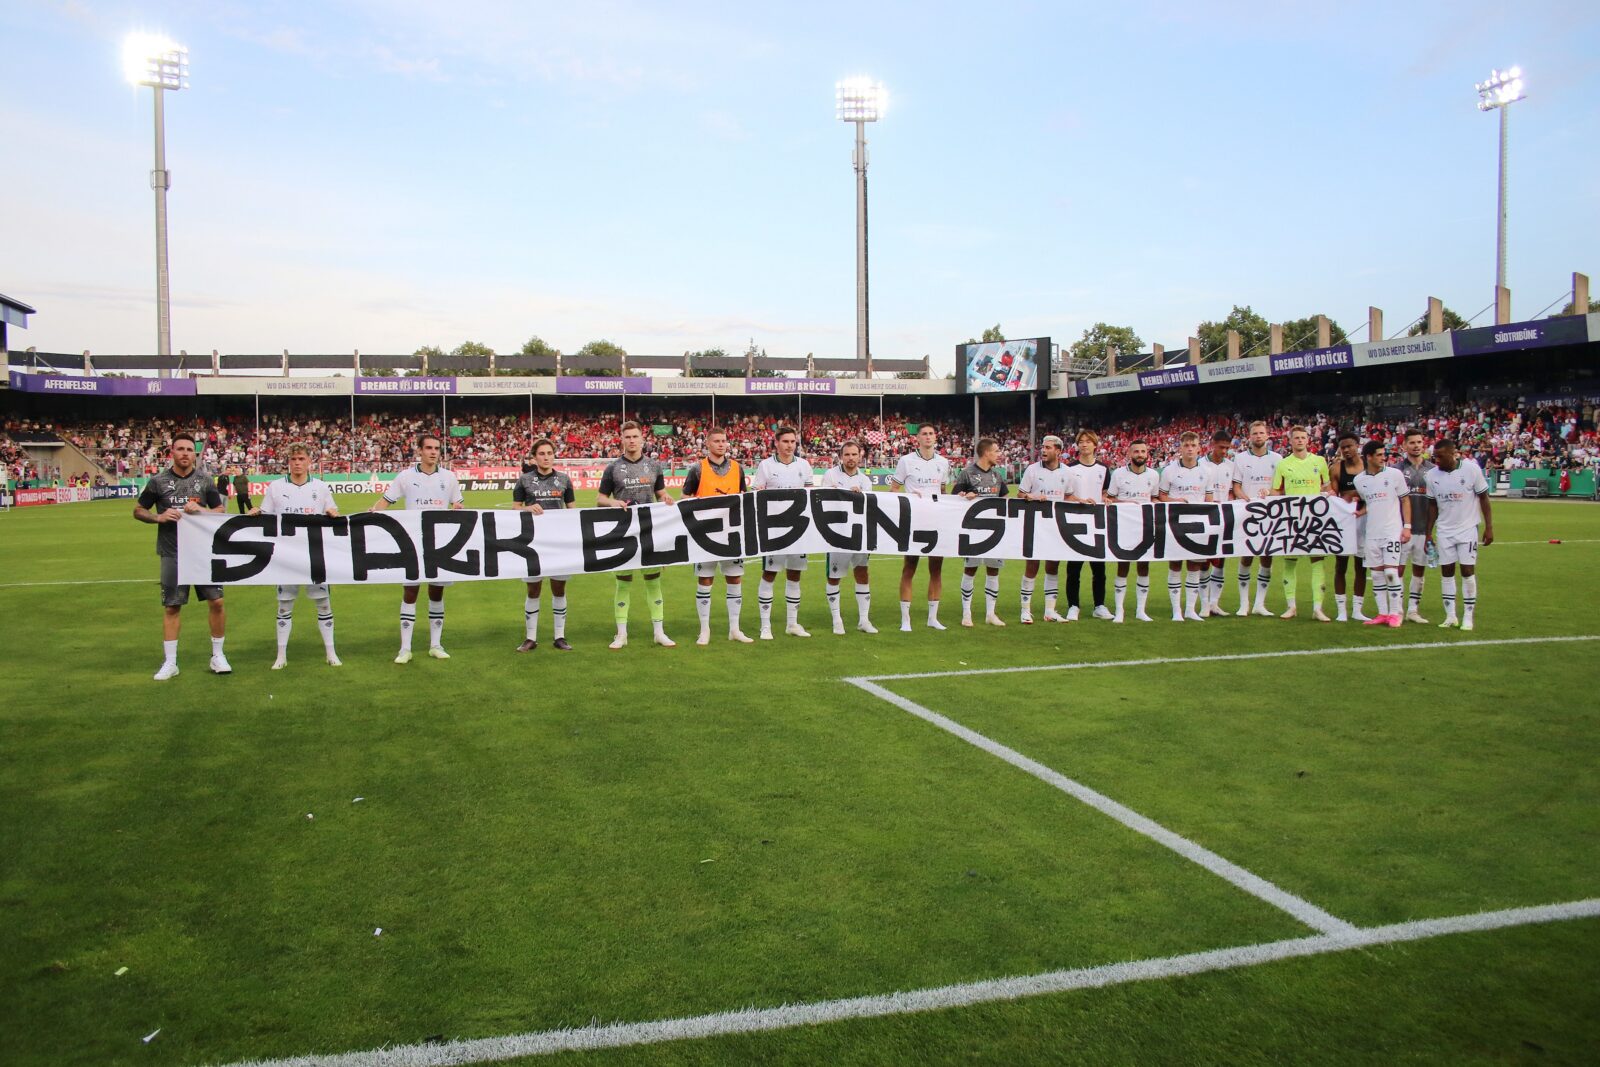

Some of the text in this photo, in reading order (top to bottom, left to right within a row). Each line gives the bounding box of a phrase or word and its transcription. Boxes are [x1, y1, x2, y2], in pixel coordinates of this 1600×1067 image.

[1274, 356, 1304, 371] BREMER
[1315, 350, 1348, 366] BRÜCKE
[44, 379, 97, 391] AFFENFELSEN
[360, 381, 399, 391] BREMER
[413, 379, 451, 391] BRÜCKE
[585, 380, 624, 390] OSTKURVE
[750, 381, 784, 391] BREMER
[797, 380, 831, 391] BRÜCKE
[1141, 375, 1164, 387] BREMER
[1171, 370, 1195, 383] BRÜCKE
[471, 480, 499, 490] bwin
[1245, 496, 1329, 520] SOTTO
[1243, 515, 1343, 538] CULTURA
[211, 510, 541, 584] STARK
[579, 488, 938, 573] BLEIBEN,
[1245, 533, 1344, 556] ULTRAS
[1386, 541, 1400, 553] 28
